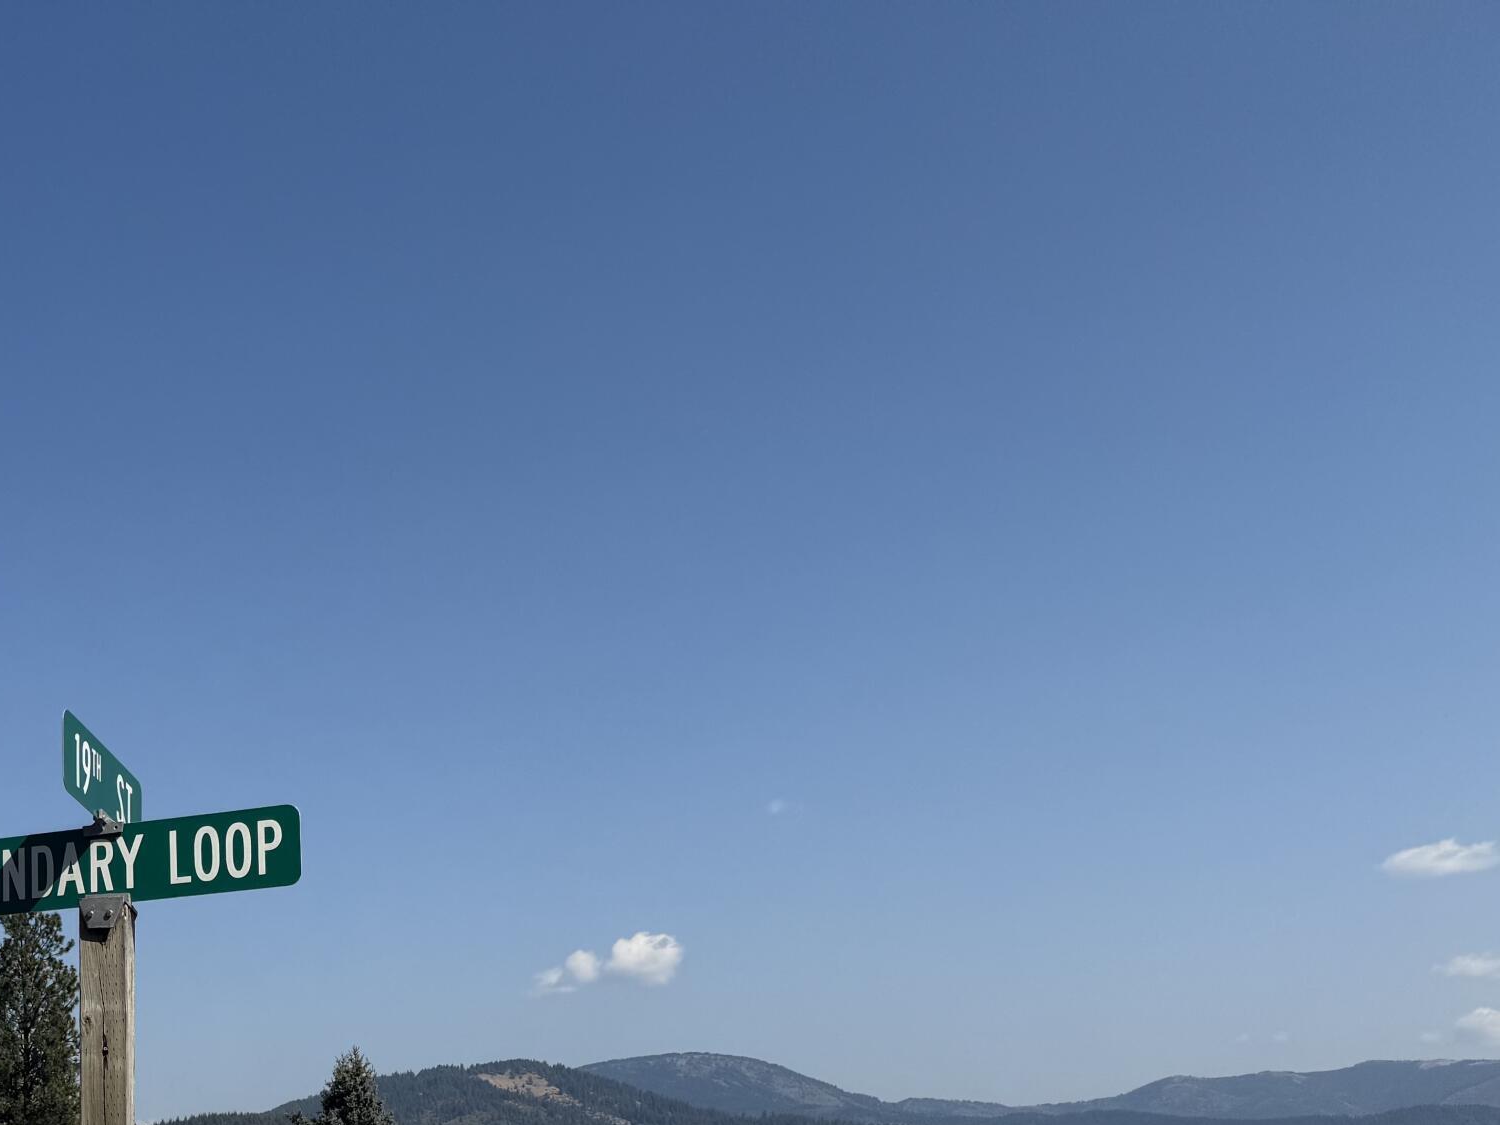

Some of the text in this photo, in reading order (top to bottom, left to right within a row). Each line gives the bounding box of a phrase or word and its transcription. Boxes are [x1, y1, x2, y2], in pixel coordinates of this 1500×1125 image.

[74, 733, 133, 823] 19TH ST
[168, 819, 282, 885] LOOP
